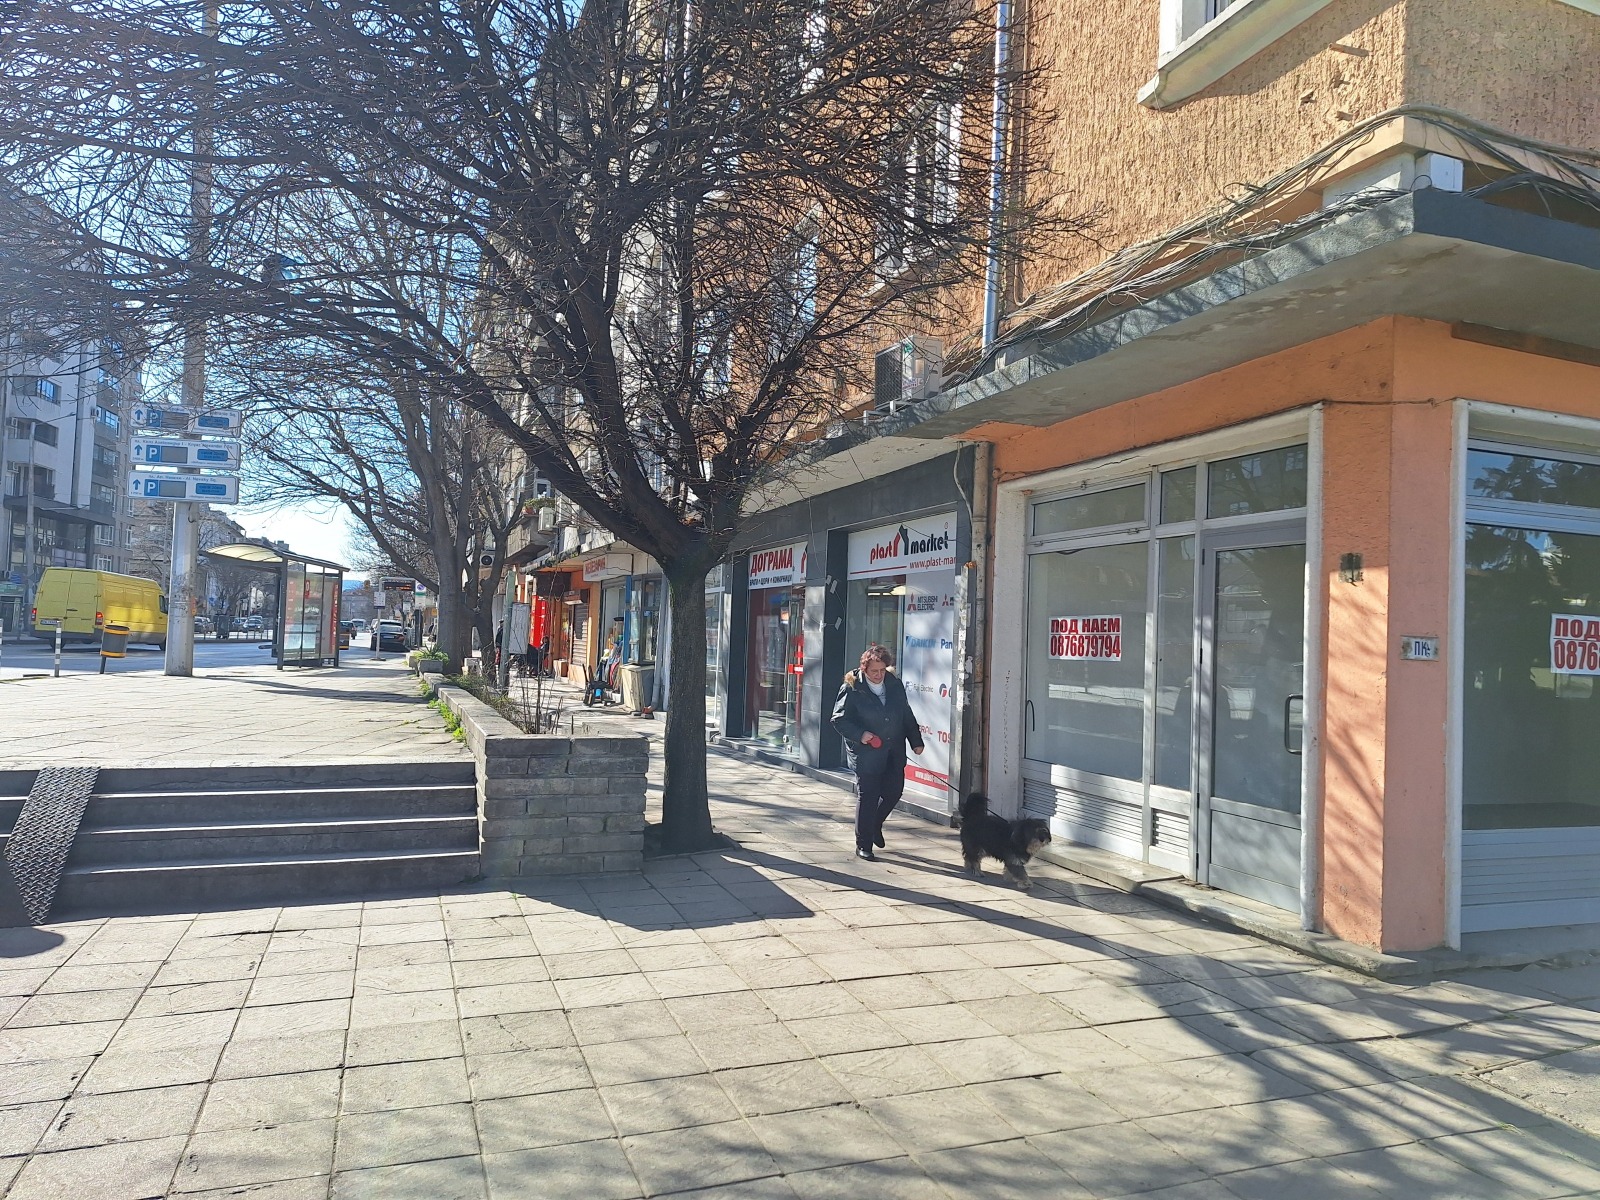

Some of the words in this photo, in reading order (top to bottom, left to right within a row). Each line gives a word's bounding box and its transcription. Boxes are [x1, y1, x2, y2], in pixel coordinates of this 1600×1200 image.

[149, 412, 158, 424] P
[149, 447, 158, 459] P
[147, 481, 156, 493] P
[870, 541, 893, 564] plast
[911, 530, 949, 555] market
[750, 547, 793, 577] ДОГРАМА
[917, 603, 935, 611] ELECTRIC
[1051, 619, 1078, 634] ПОД
[1082, 618, 1120, 633] НАЕМ
[1555, 618, 1600, 642] ПОД
[911, 639, 936, 648] DAIKIN
[940, 639, 953, 649] Pan
[1050, 635, 1121, 658] 0876879794
[1554, 640, 1600, 670] 0876
